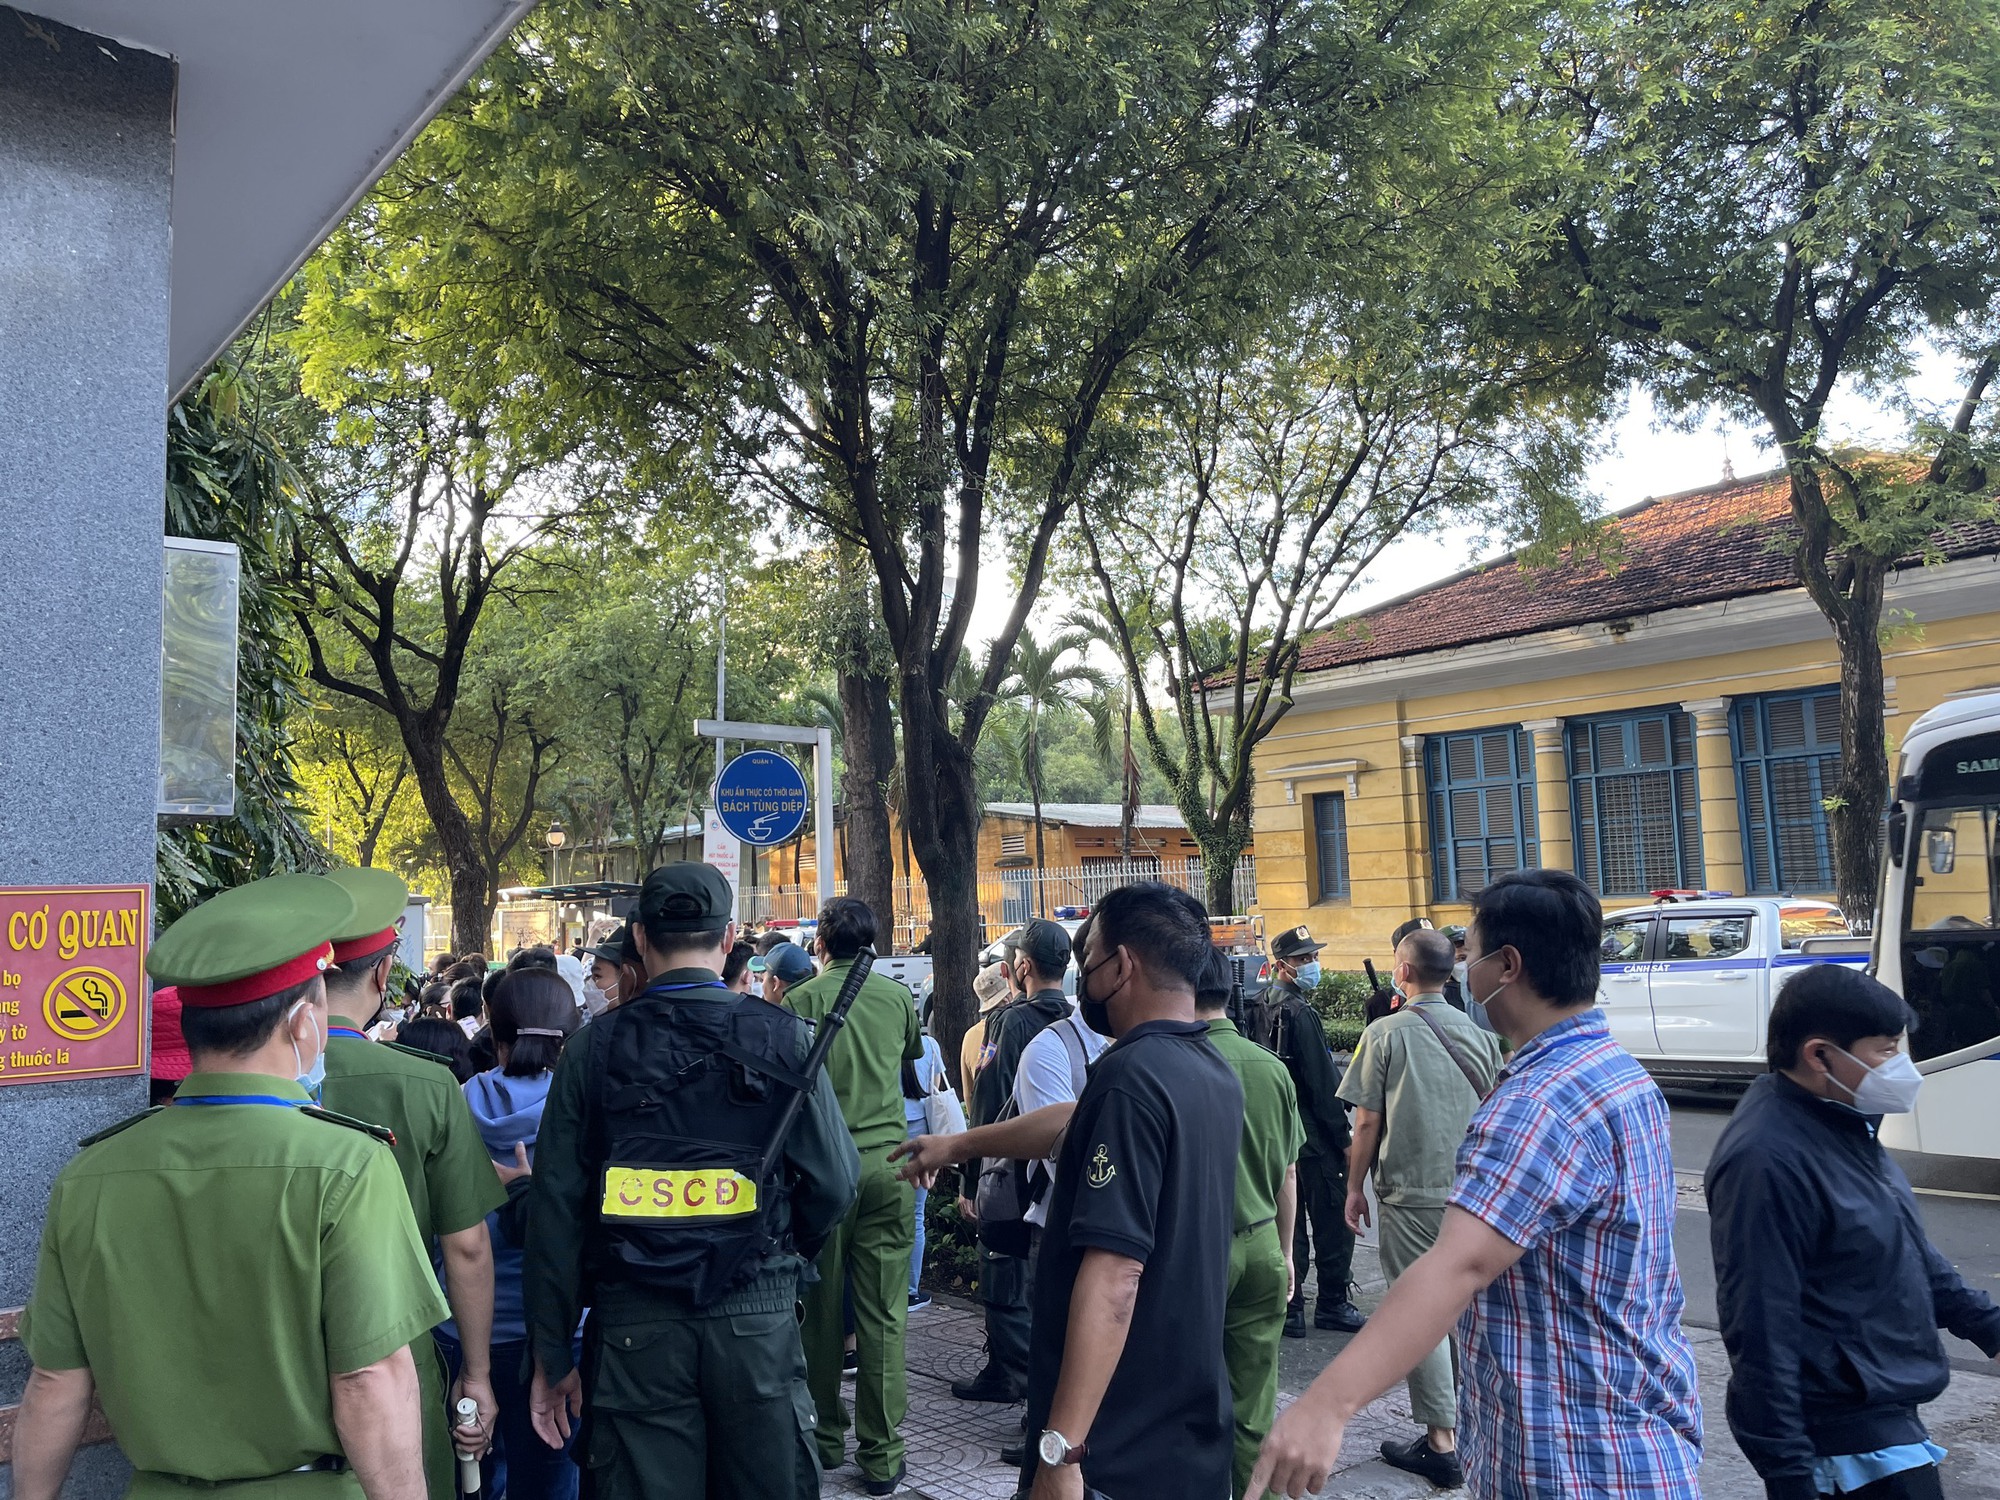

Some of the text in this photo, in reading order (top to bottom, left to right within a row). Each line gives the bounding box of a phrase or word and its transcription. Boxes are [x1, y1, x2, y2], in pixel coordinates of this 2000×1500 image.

[721, 788, 734, 796] KHU
[746, 787, 762, 798] THỰC
[788, 788, 802, 796] GIAN
[722, 799, 803, 814] BÁCH TÙNG DIỆP
[8, 904, 139, 960] CƠ QUAN
[1623, 963, 1671, 973] CẢNH SÁT
[3, 969, 21, 989] bọ
[0, 1001, 20, 1016] ng
[11, 1023, 28, 1041] tờ
[10, 1047, 52, 1068] thuốc
[56, 1047, 70, 1064] lá
[619, 1177, 739, 1208] CSCĐ
